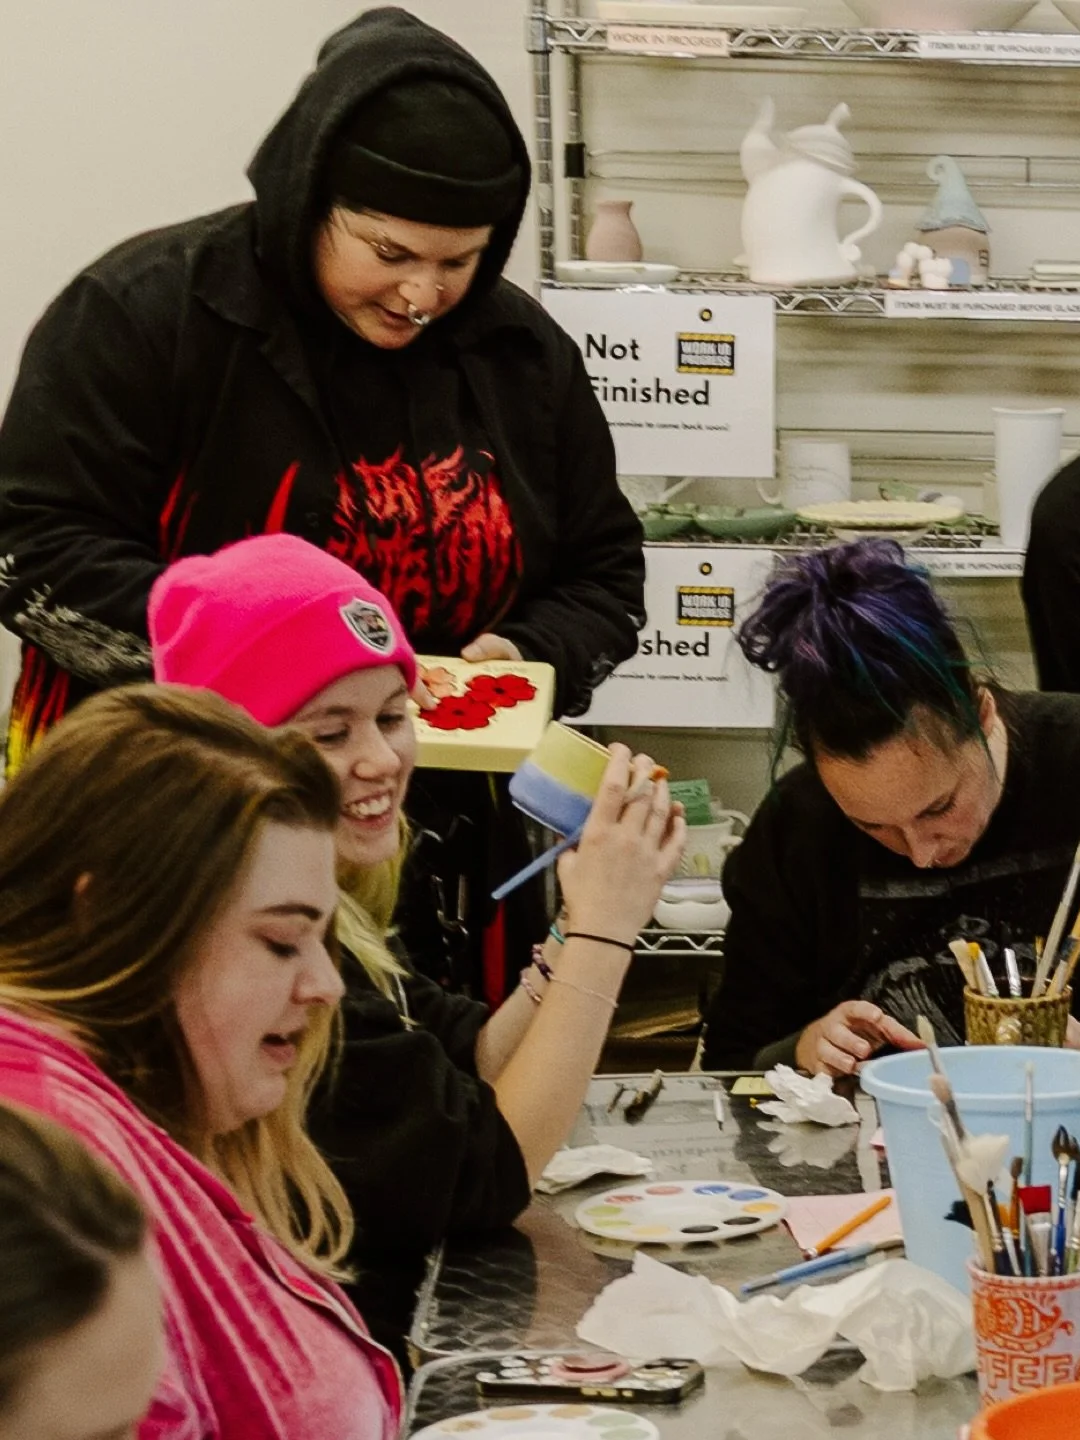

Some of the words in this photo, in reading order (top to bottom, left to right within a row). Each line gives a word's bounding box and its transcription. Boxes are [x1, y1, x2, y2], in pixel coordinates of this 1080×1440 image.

[586, 333, 640, 361] Not
[681, 341, 717, 355] WORK
[681, 594, 717, 608] WORK
[640, 629, 709, 657] shed
